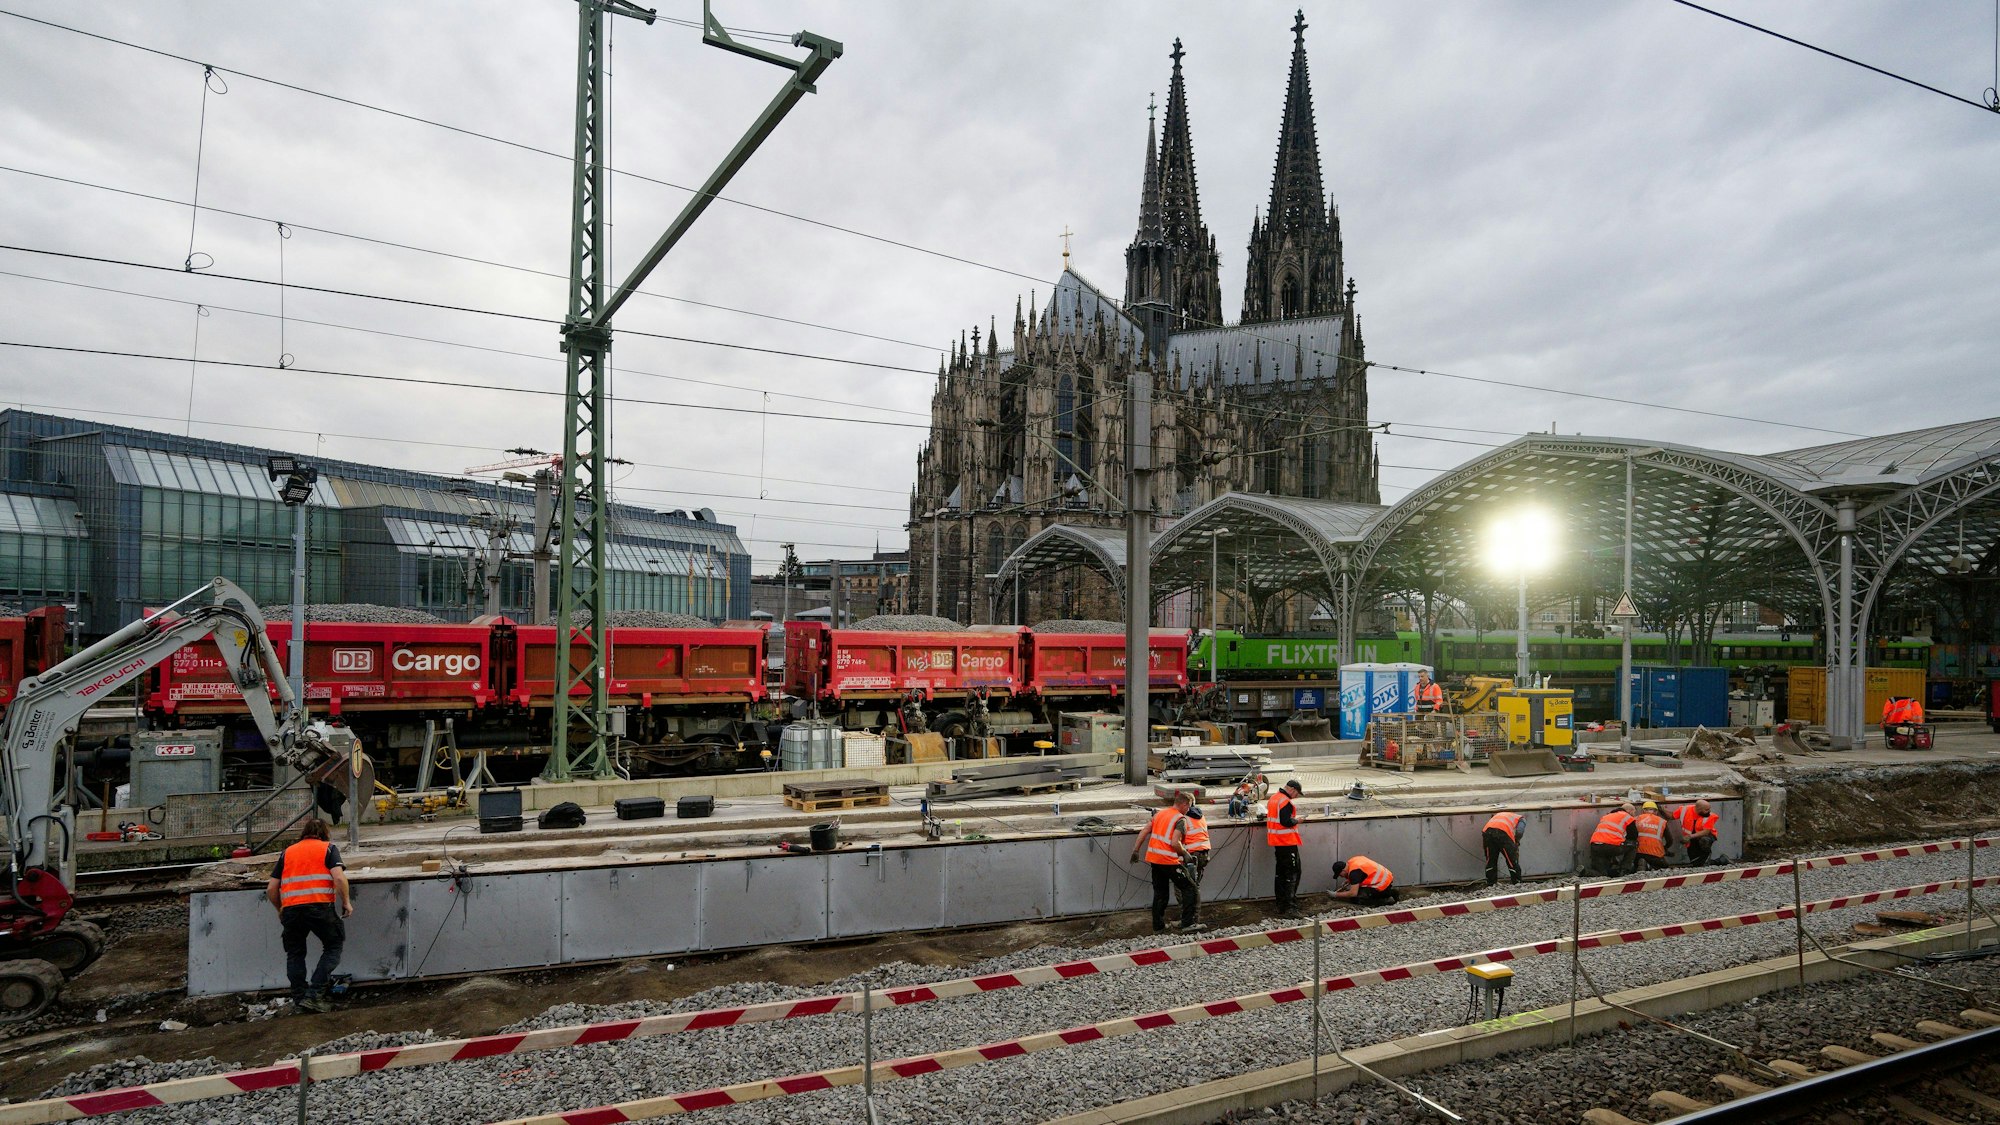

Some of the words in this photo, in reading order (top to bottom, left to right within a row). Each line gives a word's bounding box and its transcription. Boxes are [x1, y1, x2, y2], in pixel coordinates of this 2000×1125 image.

[337, 652, 370, 669] DB
[392, 648, 481, 676] Cargo
[933, 652, 952, 667] DB
[961, 653, 1004, 670] Cargo
[76, 658, 146, 697] TAKEUCHI
[24, 709, 42, 738] Balter
[1758, 803, 1772, 824] 7
